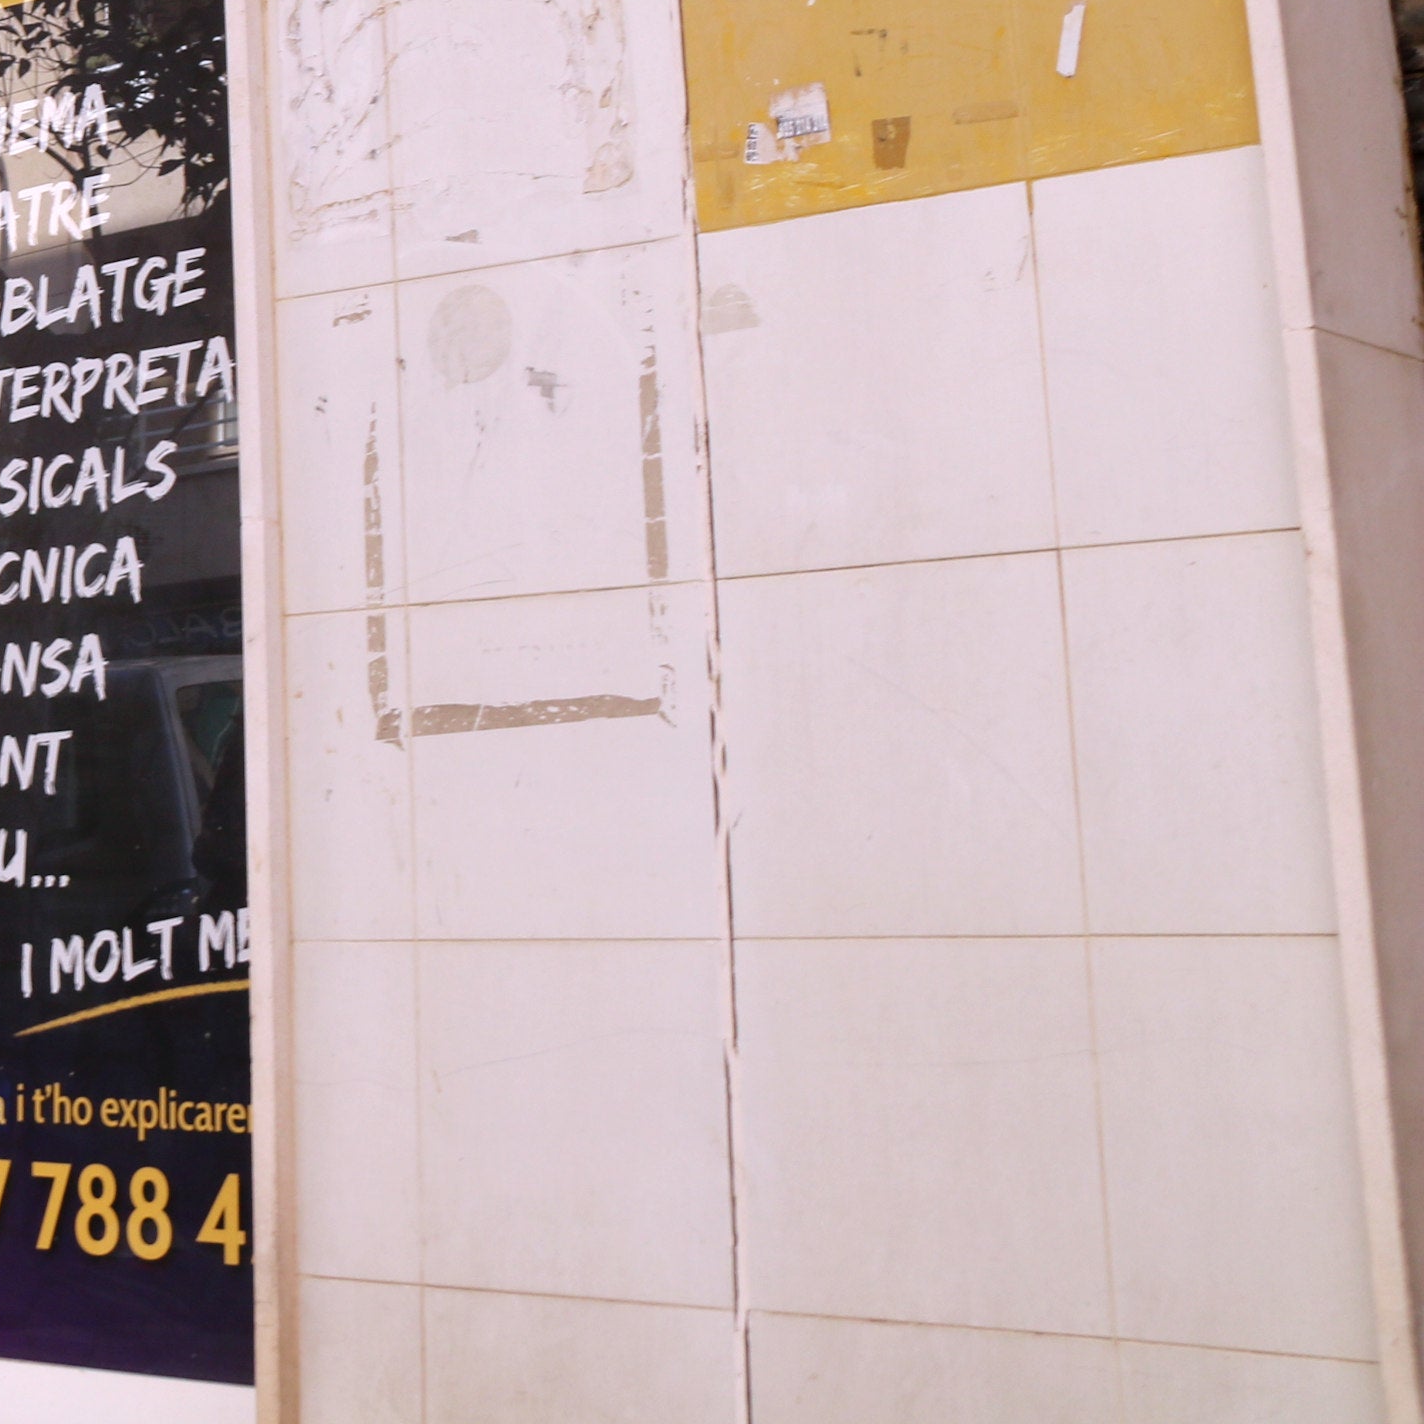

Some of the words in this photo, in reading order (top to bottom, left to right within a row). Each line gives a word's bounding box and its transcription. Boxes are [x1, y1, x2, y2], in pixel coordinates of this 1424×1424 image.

[20, 943, 33, 999] I
[51, 916, 183, 994] MOLT
[16, 1083, 26, 1123] i
[32, 1082, 94, 1127] t'ho
[31, 1161, 173, 1261] 788
